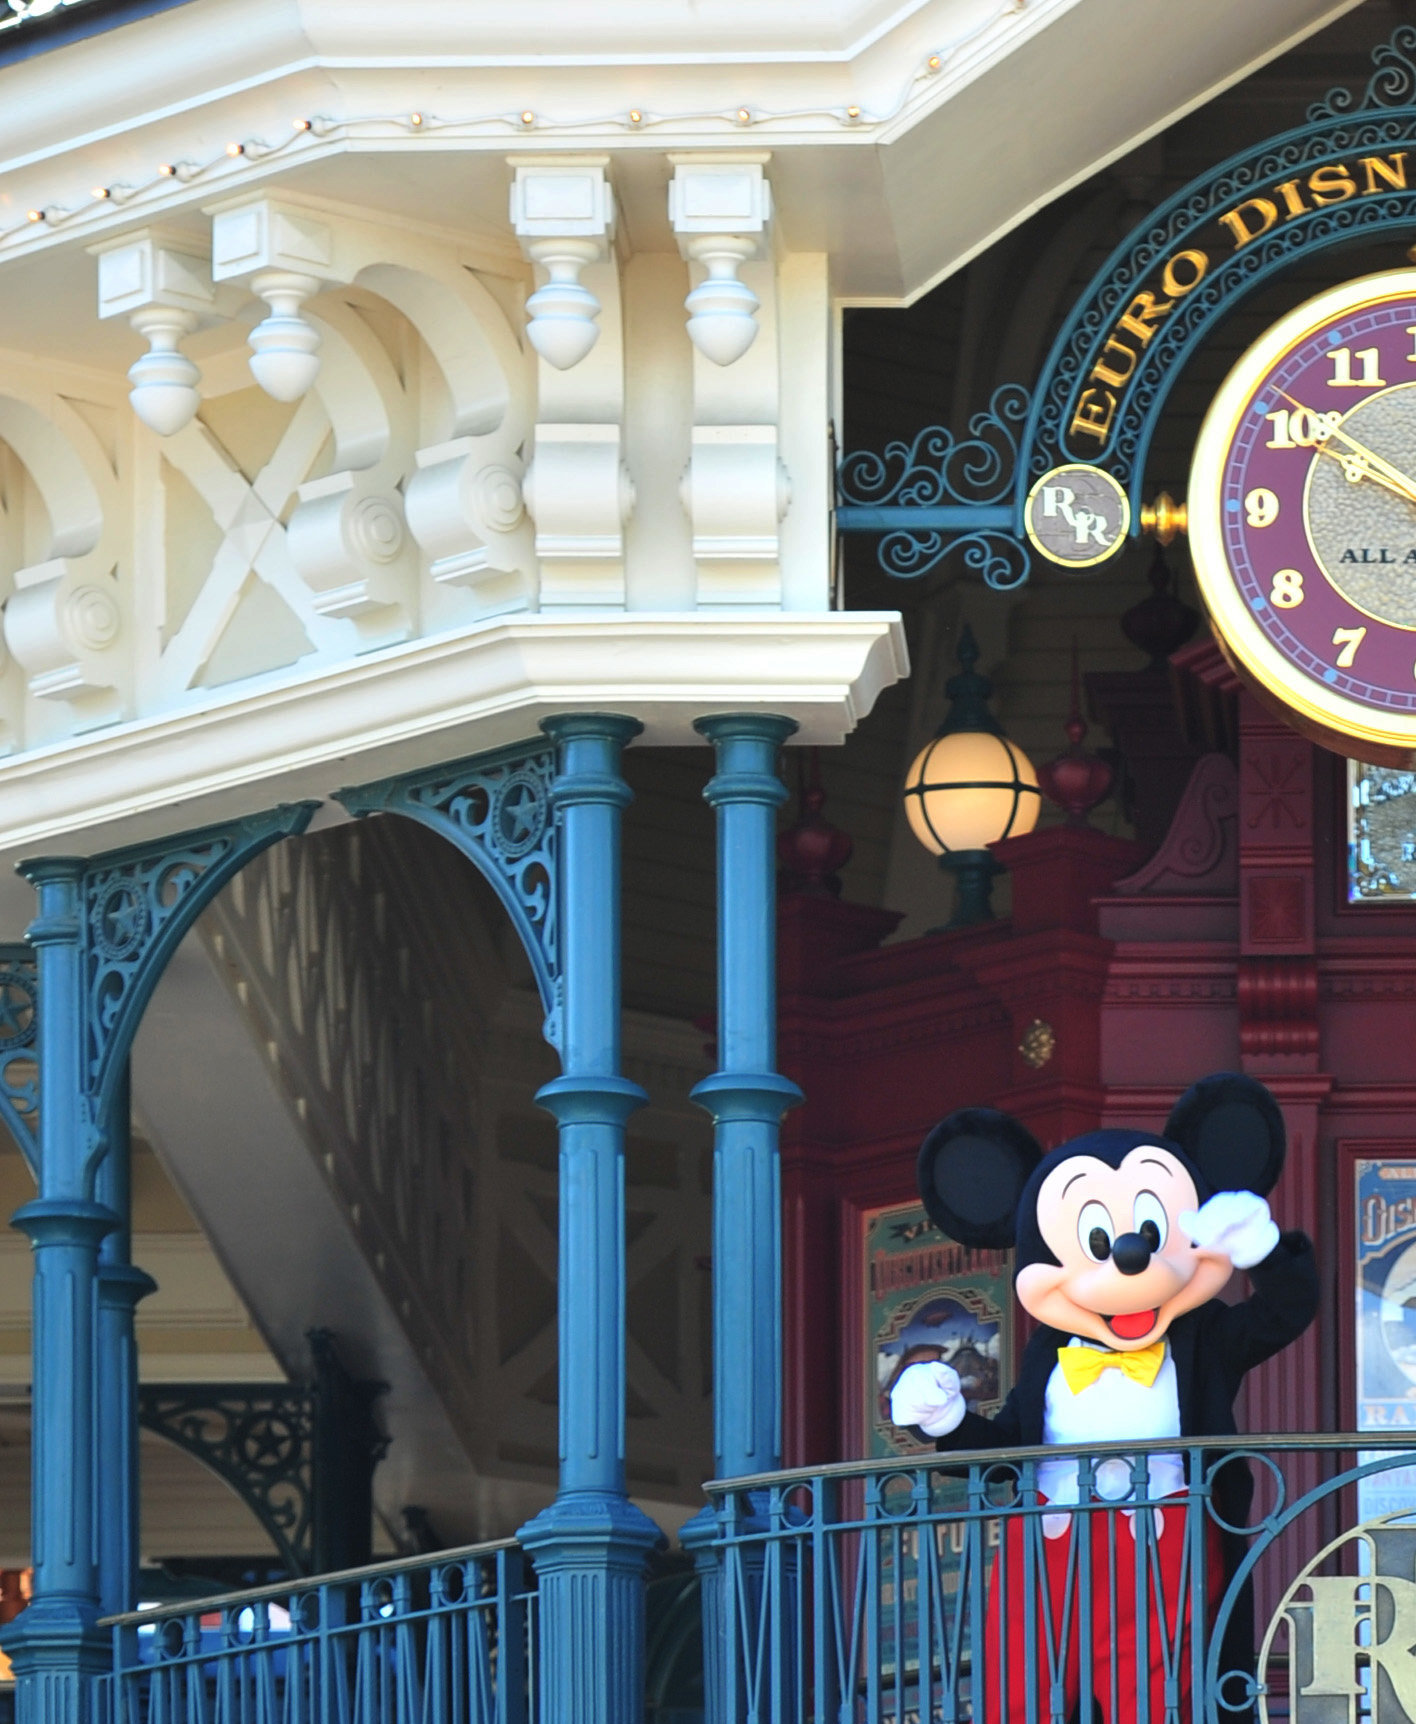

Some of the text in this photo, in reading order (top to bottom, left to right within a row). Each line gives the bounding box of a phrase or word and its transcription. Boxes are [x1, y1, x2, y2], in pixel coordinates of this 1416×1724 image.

[1068, 248, 1210, 446] EURO
[1326, 346, 1387, 387] 11
[1265, 408, 1319, 450] 10
[1244, 488, 1280, 528] 9
[1339, 548, 1397, 565] ALL
[1270, 569, 1305, 609] 8
[1331, 627, 1367, 668] 7
